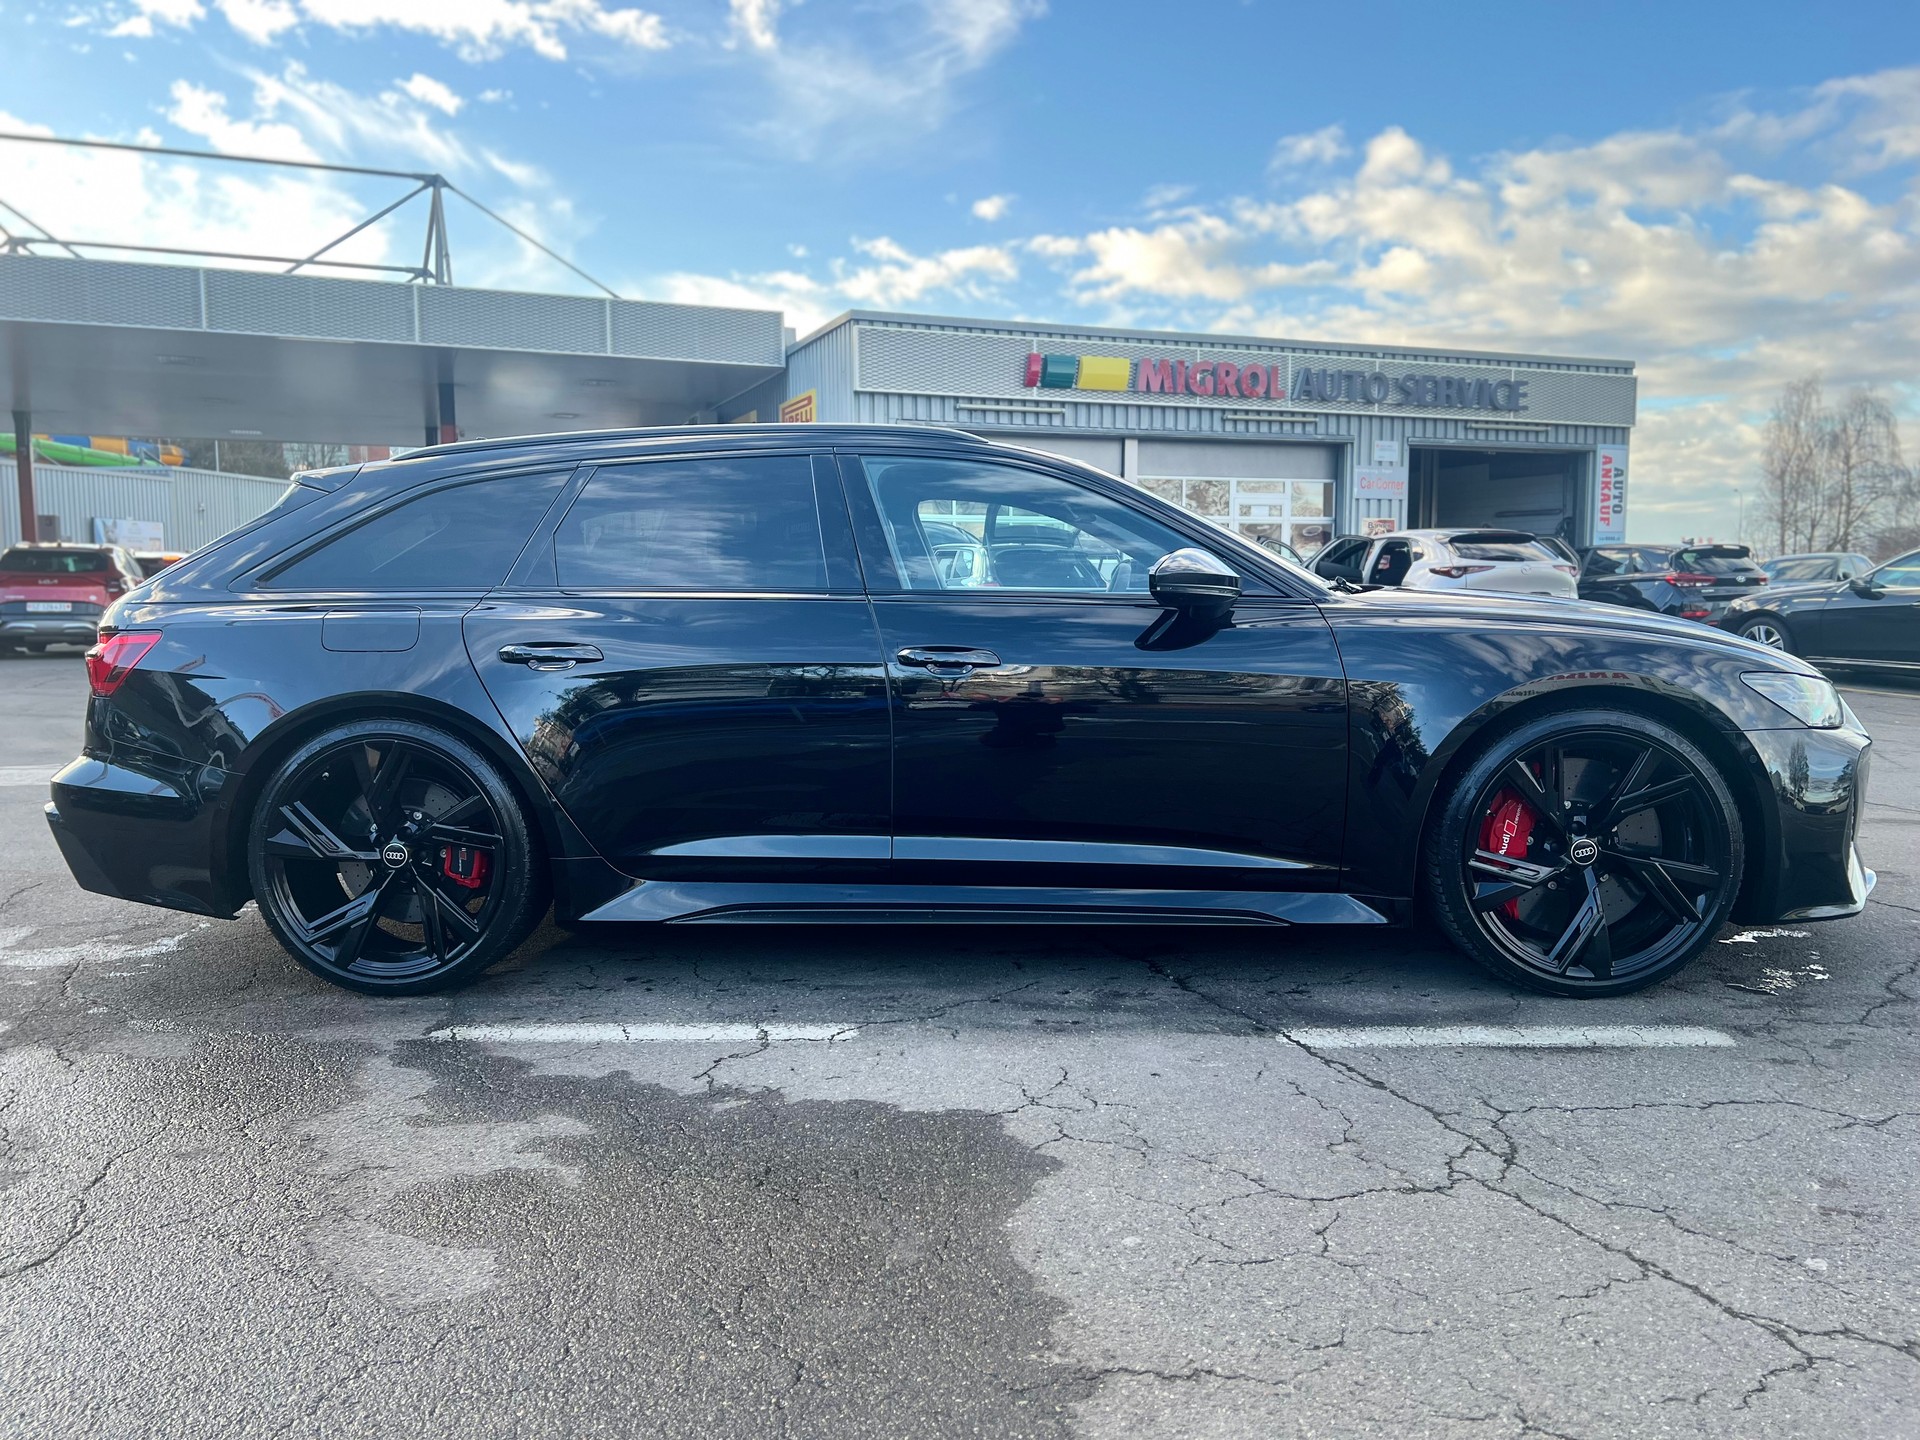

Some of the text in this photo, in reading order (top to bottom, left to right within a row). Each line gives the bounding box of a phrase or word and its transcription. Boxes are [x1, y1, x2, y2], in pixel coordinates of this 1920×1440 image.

[1138, 358, 1529, 411] MIGROL AUTO SERVICE
[1599, 455, 1614, 527] ANKAUF
[1612, 467, 1625, 515] AUTO
[1499, 833, 1511, 855] Audi
